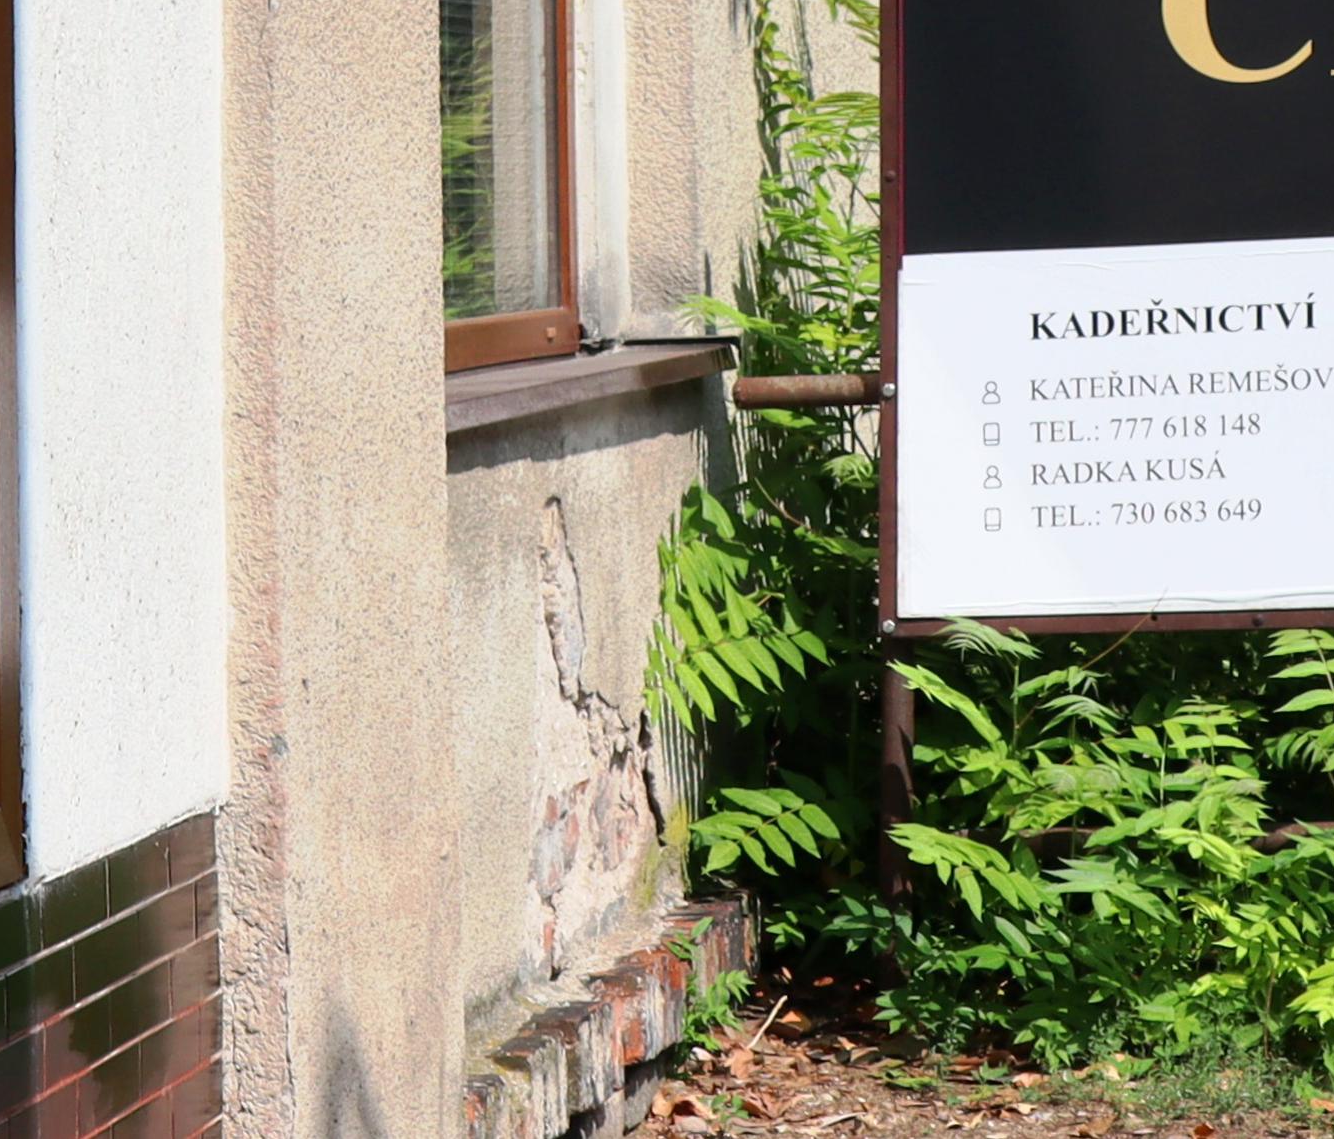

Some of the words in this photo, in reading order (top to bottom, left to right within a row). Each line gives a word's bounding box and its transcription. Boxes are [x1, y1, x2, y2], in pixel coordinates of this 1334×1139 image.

[1030, 291, 1316, 341] KADEŘNICTVÍ
[1030, 370, 1180, 401] KATEŘINA
[1030, 420, 1100, 444] TEL.:
[1110, 417, 1153, 439] 777
[1162, 415, 1207, 438] 618
[1220, 413, 1261, 436] 148
[1032, 460, 1137, 486] RADKA
[1146, 450, 1226, 482] KUSÁ
[1031, 505, 1102, 529] TEL.:
[1111, 502, 1155, 525] 730
[1163, 500, 1207, 523] 683
[1217, 498, 1262, 521] 649
